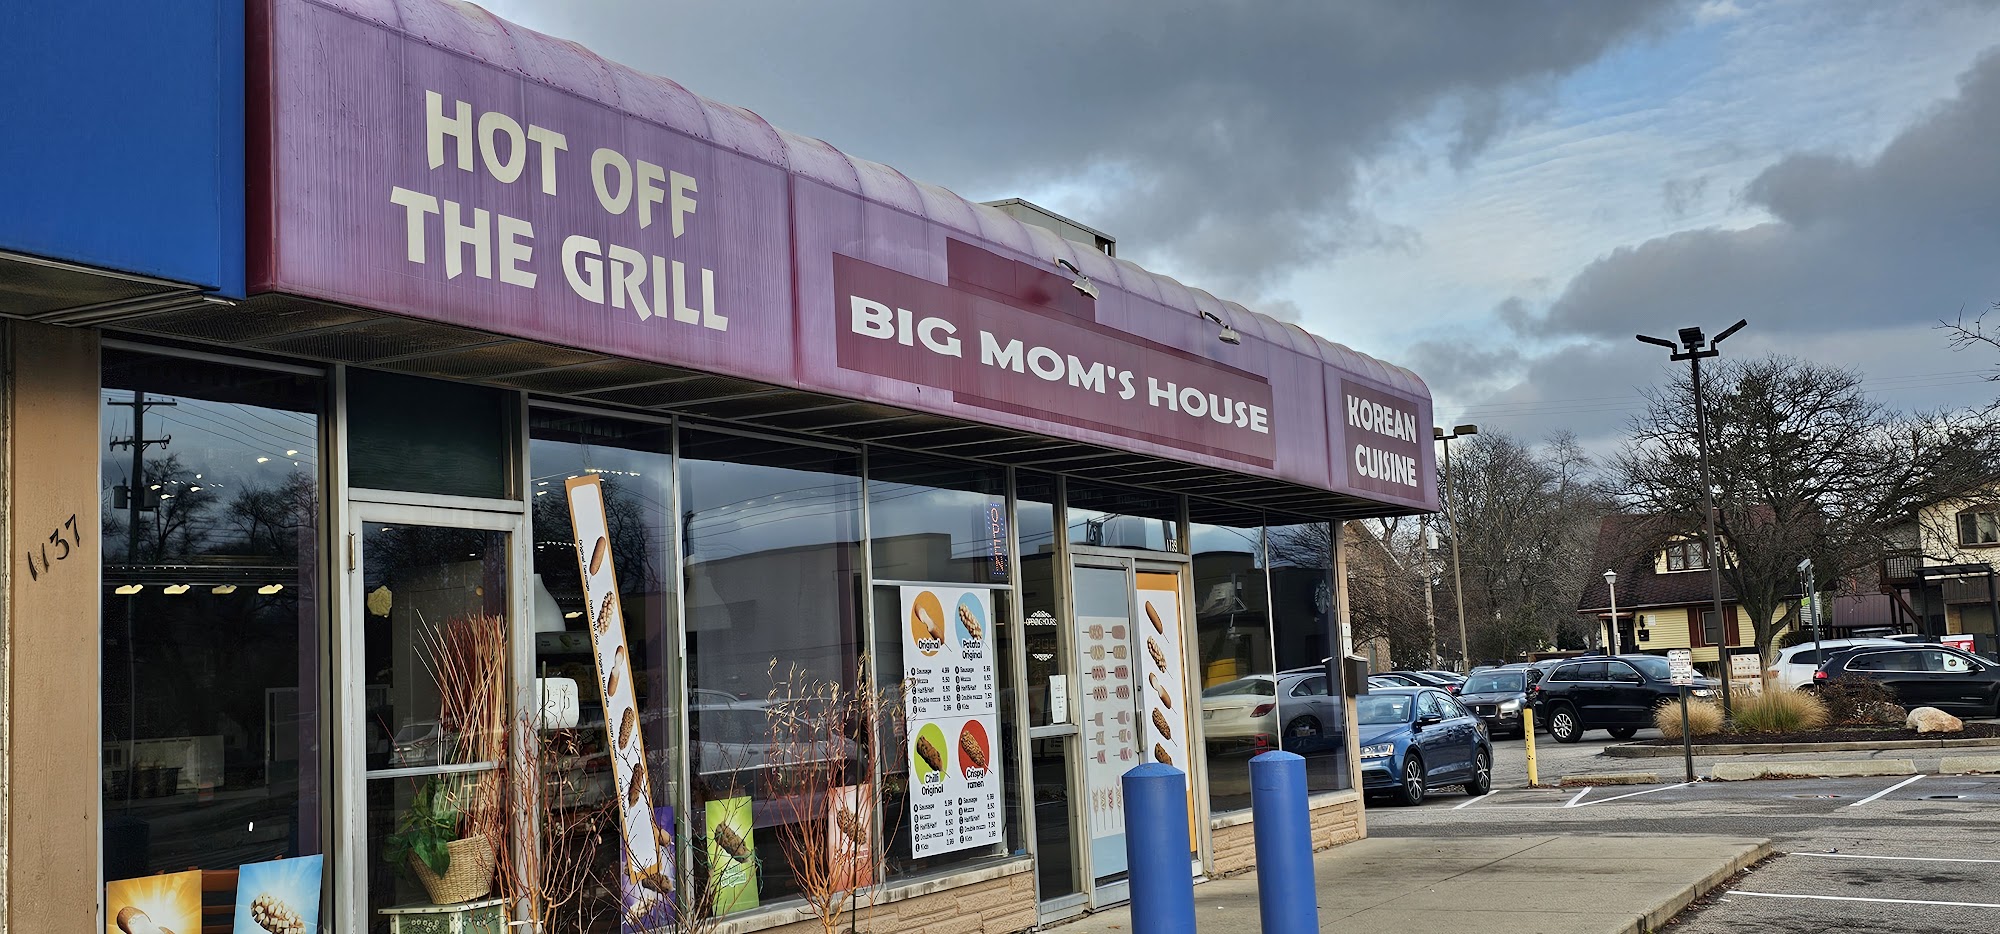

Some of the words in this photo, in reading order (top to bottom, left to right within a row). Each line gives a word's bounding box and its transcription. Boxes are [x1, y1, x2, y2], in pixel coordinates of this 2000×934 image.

[426, 89, 568, 196] HOT
[591, 147, 698, 238] OFF
[390, 185, 537, 288] THE
[561, 234, 729, 331] GRILL
[850, 295, 962, 358] BIG
[980, 330, 1135, 400] MOM'S
[1148, 376, 1270, 434] HOUSE
[1346, 394, 1417, 444] KOREAN
[1354, 444, 1417, 488] CUISINE
[27, 514, 81, 581] 1137
[578, 539, 586, 563] Original
[991, 507, 1004, 571] OPEN
[918, 639, 940, 652] Original
[962, 640, 981, 649] Potato
[962, 650, 983, 661] Original
[921, 784, 944, 797] Original
[966, 767, 984, 780] Crispy
[967, 780, 985, 789] ramen
